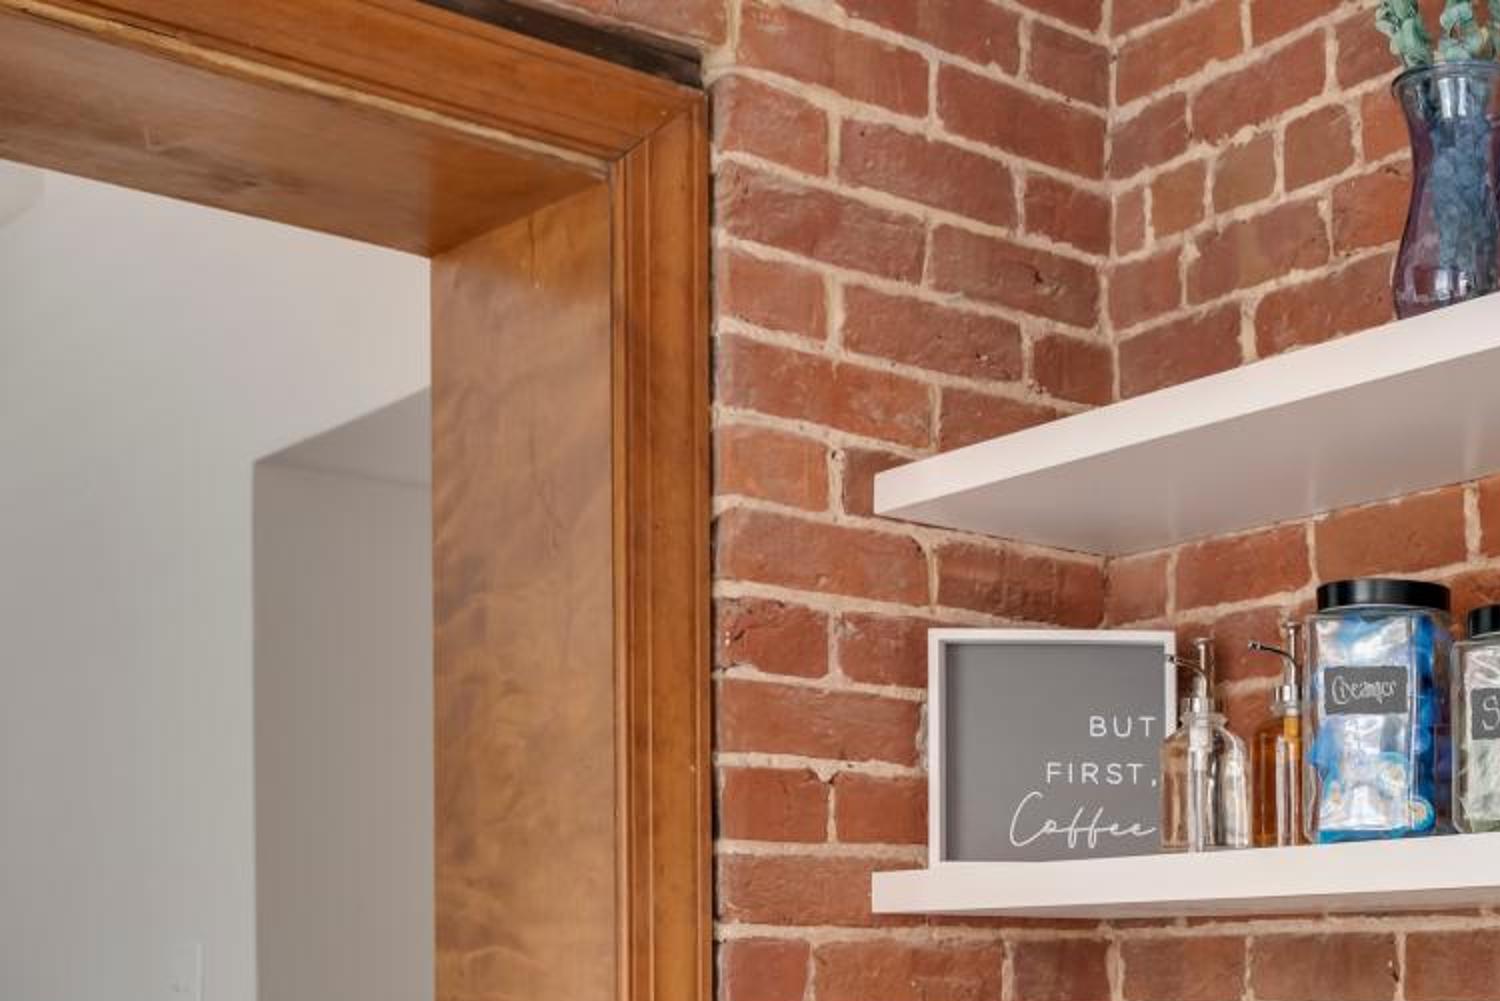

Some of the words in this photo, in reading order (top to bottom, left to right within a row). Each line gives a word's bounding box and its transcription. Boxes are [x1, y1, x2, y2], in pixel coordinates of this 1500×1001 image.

[1089, 715, 1156, 737] BUT
[1046, 762, 1157, 787] FIRST,
[1009, 791, 1158, 849] Coffee
